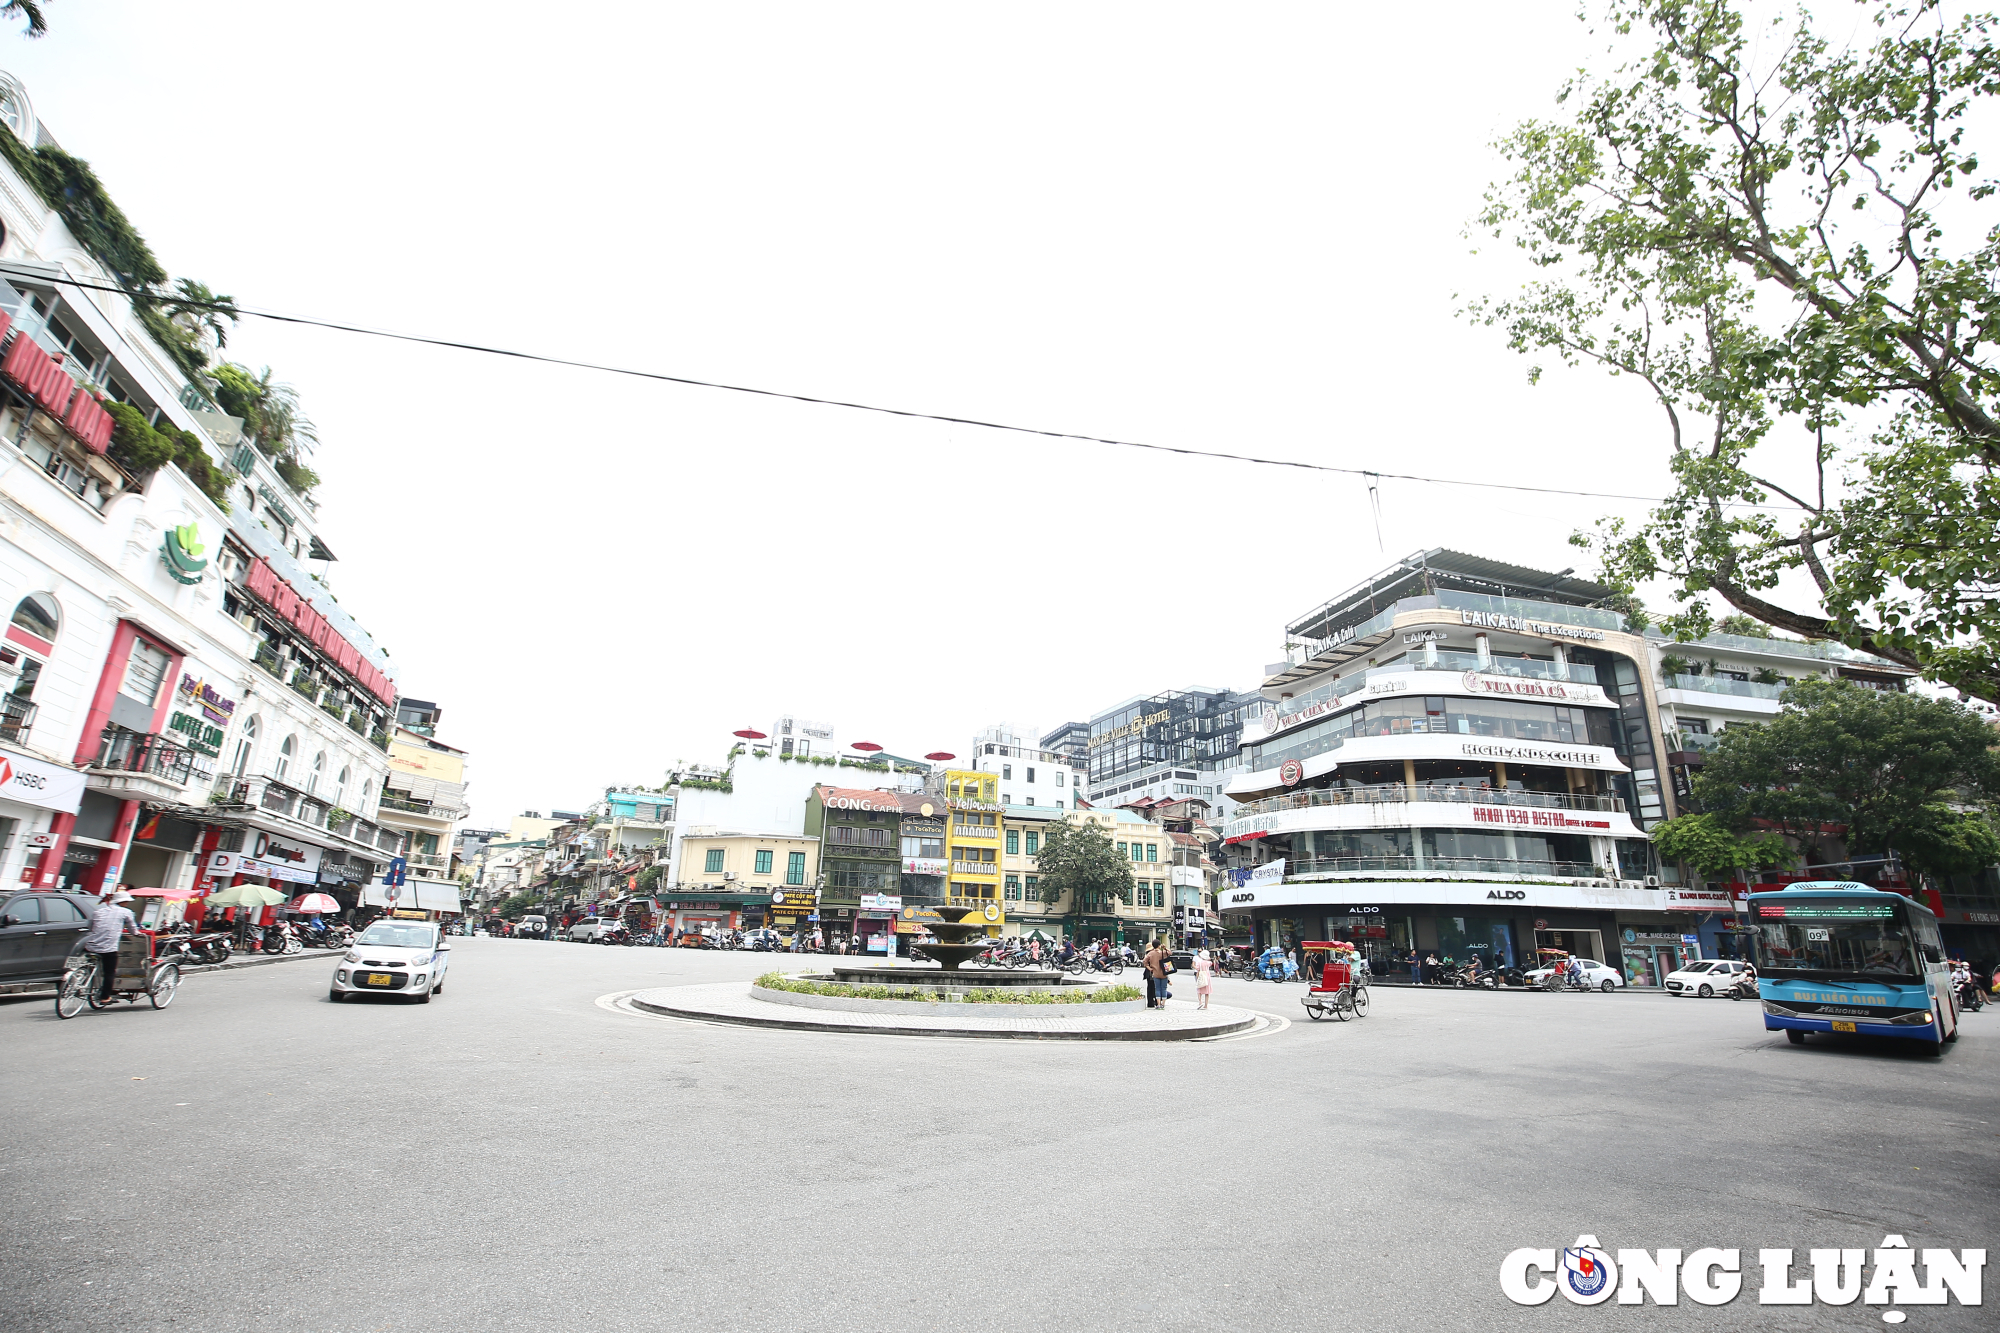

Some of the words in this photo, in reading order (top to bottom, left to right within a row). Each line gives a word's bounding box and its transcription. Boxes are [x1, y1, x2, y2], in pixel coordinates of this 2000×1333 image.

[1462, 609, 1508, 629] LAIKA
[1531, 623, 1550, 634] The
[1551, 626, 1605, 641] Exceptional
[1311, 633, 1341, 655] LAIKA
[1403, 630, 1437, 644] LAIKA
[1482, 680, 1512, 693] VUA
[1514, 681, 1545, 697] CHẢ
[1547, 683, 1567, 698] CÁ
[1281, 712, 1302, 728] VUA
[1302, 700, 1326, 719] CHẢ
[1326, 693, 1343, 711] CÁ
[1101, 731, 1111, 742] DE
[1111, 725, 1129, 739] VILLE
[1145, 709, 1170, 727] HOTEL
[1462, 743, 1548, 760] HIGHLANDS
[1549, 750, 1601, 764] COFFEE
[13, 771, 47, 790] HSBC
[956, 797, 987, 811] Yellow
[1473, 807, 1504, 823] HANOI
[1506, 809, 1530, 825] 1930
[1531, 811, 1566, 827] BISTRO
[1228, 866, 1254, 888] Tiger
[1254, 868, 1283, 879] CRYSTAL
[1231, 893, 1255, 902] ALDO
[1487, 890, 1526, 900] ALDO
[1794, 992, 1817, 1001] BUS
[1821, 992, 1848, 1003] LIÊN
[1852, 995, 1886, 1005] NINH
